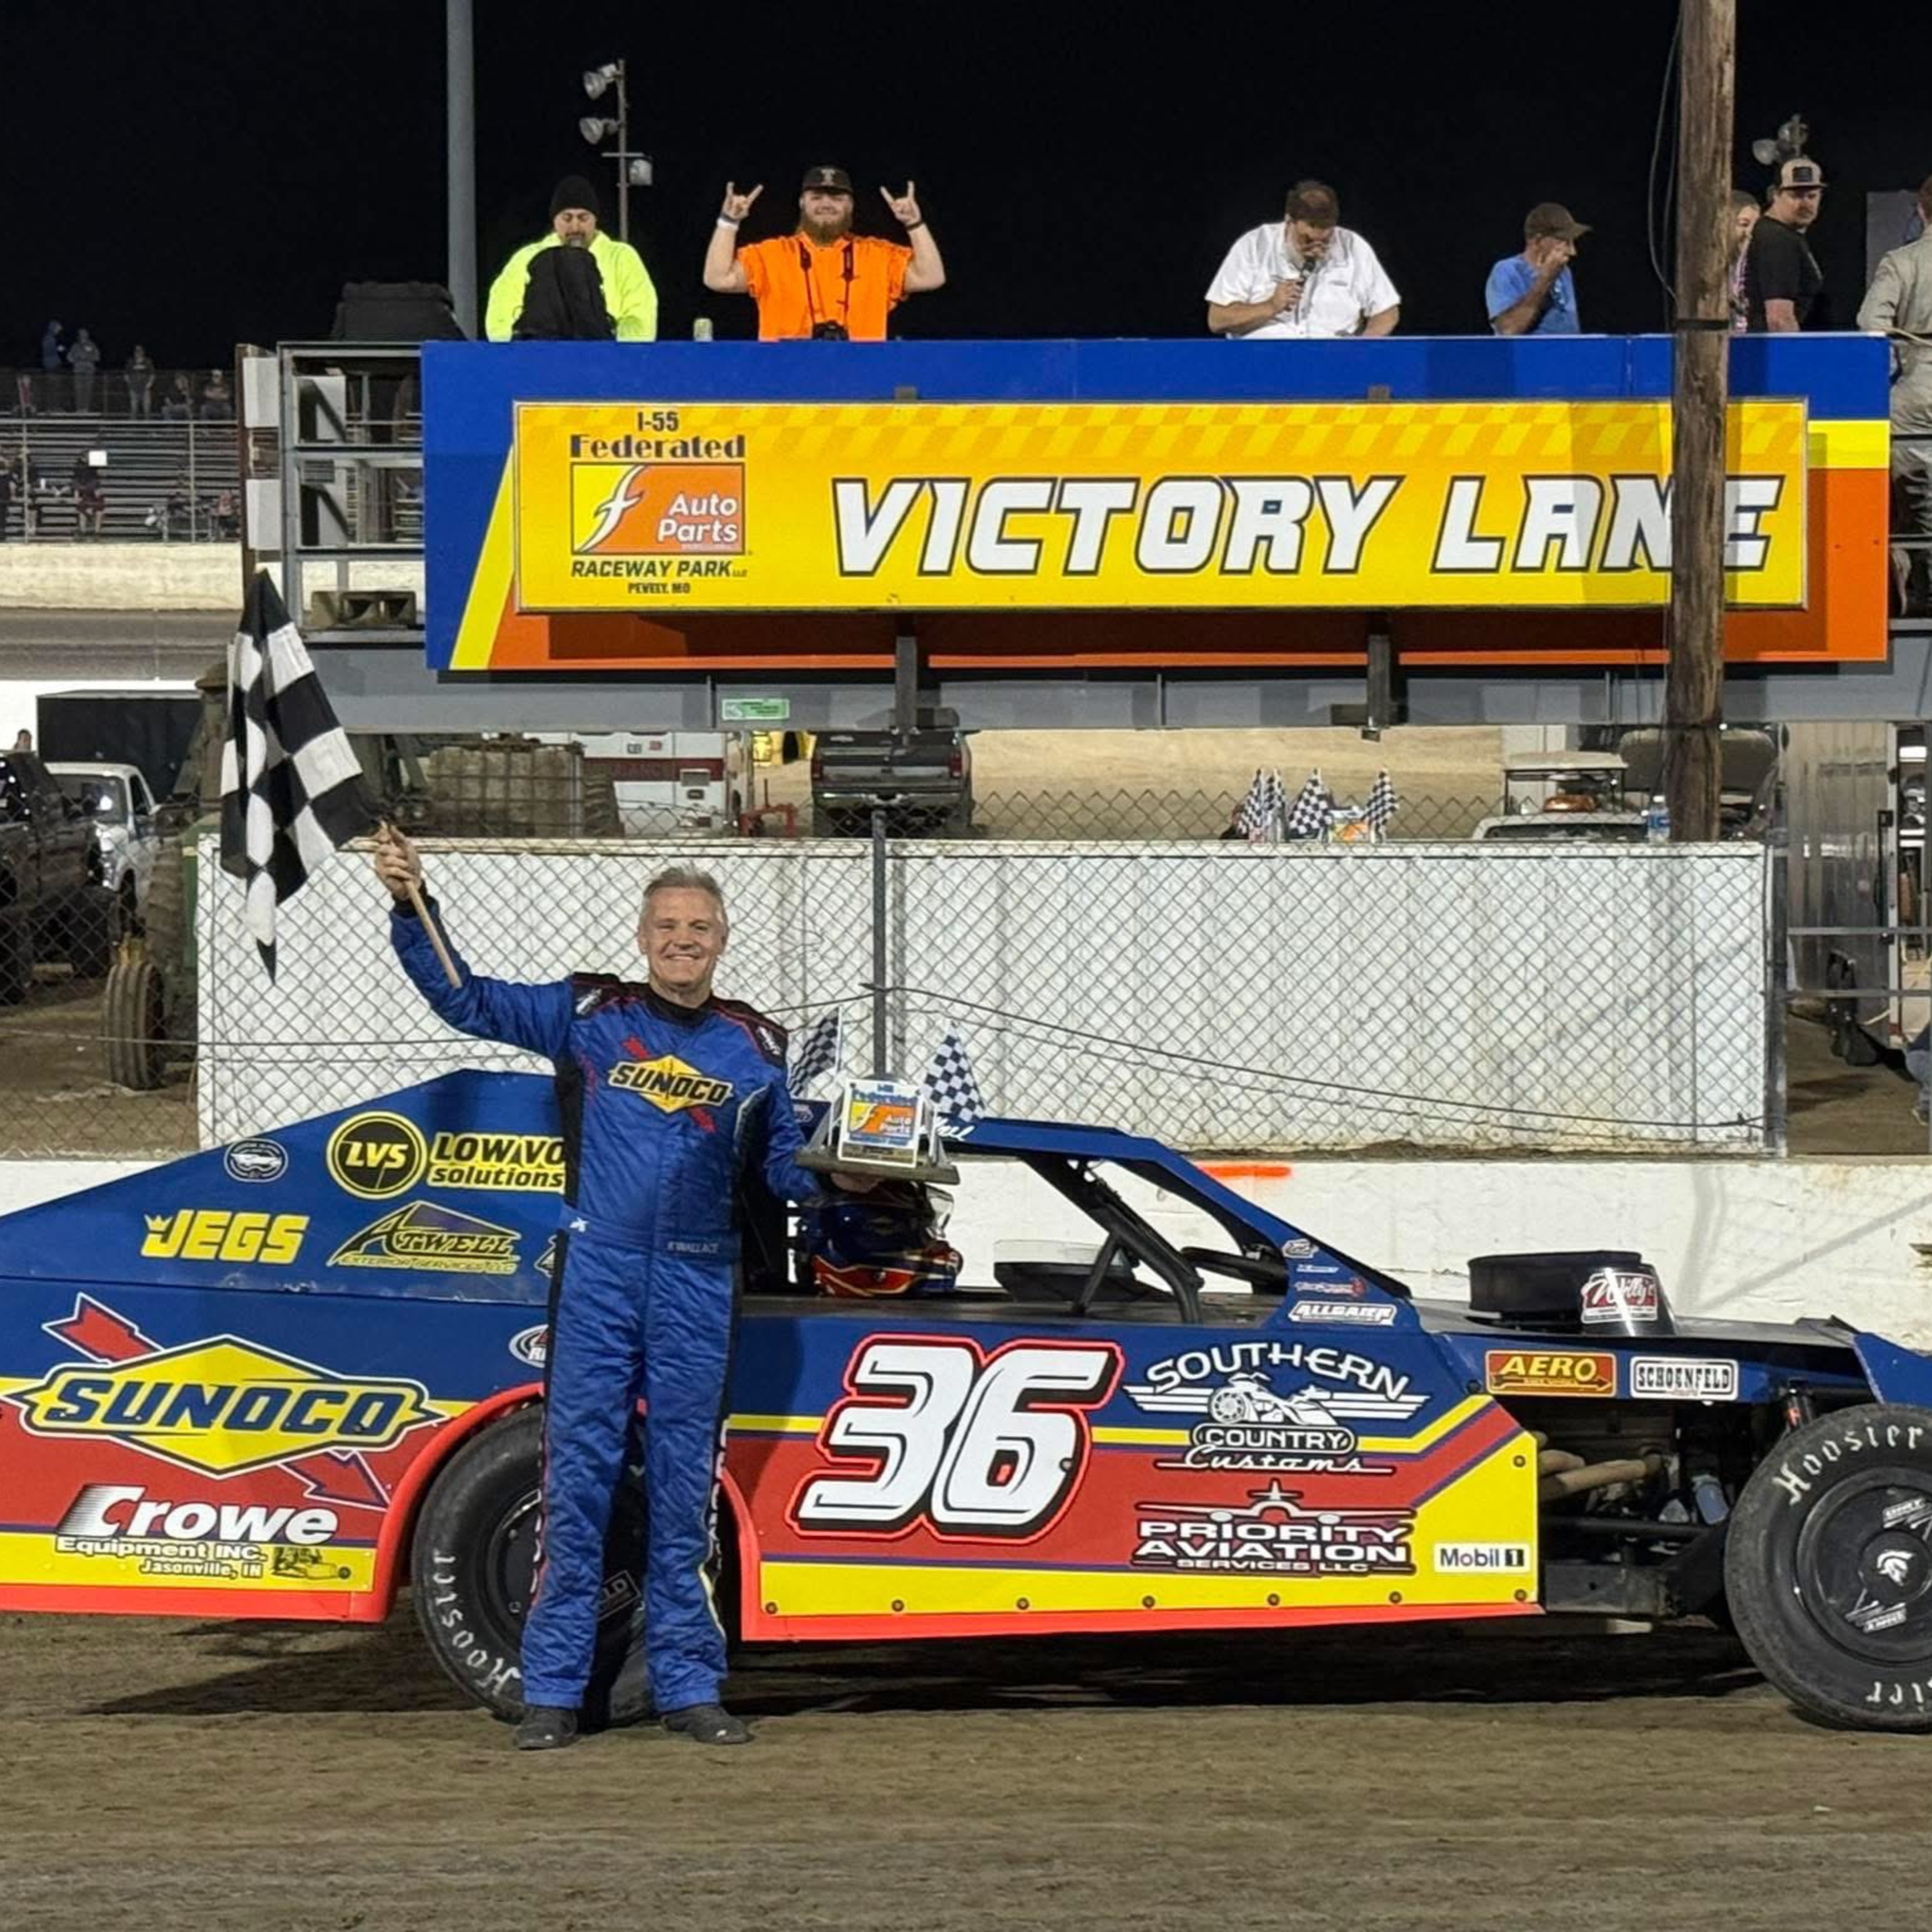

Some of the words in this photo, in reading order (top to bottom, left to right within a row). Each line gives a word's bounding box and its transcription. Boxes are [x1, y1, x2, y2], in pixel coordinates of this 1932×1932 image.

[638, 412, 679, 431] I-55
[571, 435, 745, 458] Federated
[669, 494, 737, 516] Auto
[658, 519, 739, 542] Parts
[831, 477, 1403, 576] VICTORY
[1431, 475, 1785, 572] LANE
[571, 561, 672, 577] RACEWAY
[676, 561, 732, 577] PARK
[672, 583, 690, 594] MO
[612, 1064, 730, 1103] SUNOCO
[344, 1141, 409, 1168] LVS
[431, 1166, 564, 1188] solutions
[141, 1210, 310, 1264] JEGS
[1146, 1342, 1409, 1401] SOUTHERN
[1501, 1356, 1597, 1381] AERO
[1637, 1366, 1730, 1388] SCHOENFELD
[45, 1378, 405, 1436] SUNOCO
[792, 1340, 1118, 1536] 36
[1204, 1428, 1344, 1449] COUNTRY
[1182, 1444, 1367, 1472] Customs
[1772, 1423, 1923, 1506] Hoosier
[57, 1484, 338, 1544] Crowe
[1139, 1521, 1409, 1542] PRIORITY
[57, 1537, 207, 1558] Equipment
[216, 1543, 268, 1560] INC.
[1135, 1540, 1407, 1563] AVIATION
[1440, 1548, 1500, 1567] Mobil
[1505, 1549, 1524, 1567] 1
[140, 1558, 237, 1579] Jasonville,
[242, 1563, 263, 1578] IN
[1177, 1559, 1312, 1571] SERVICES
[1319, 1561, 1370, 1572] LLC
